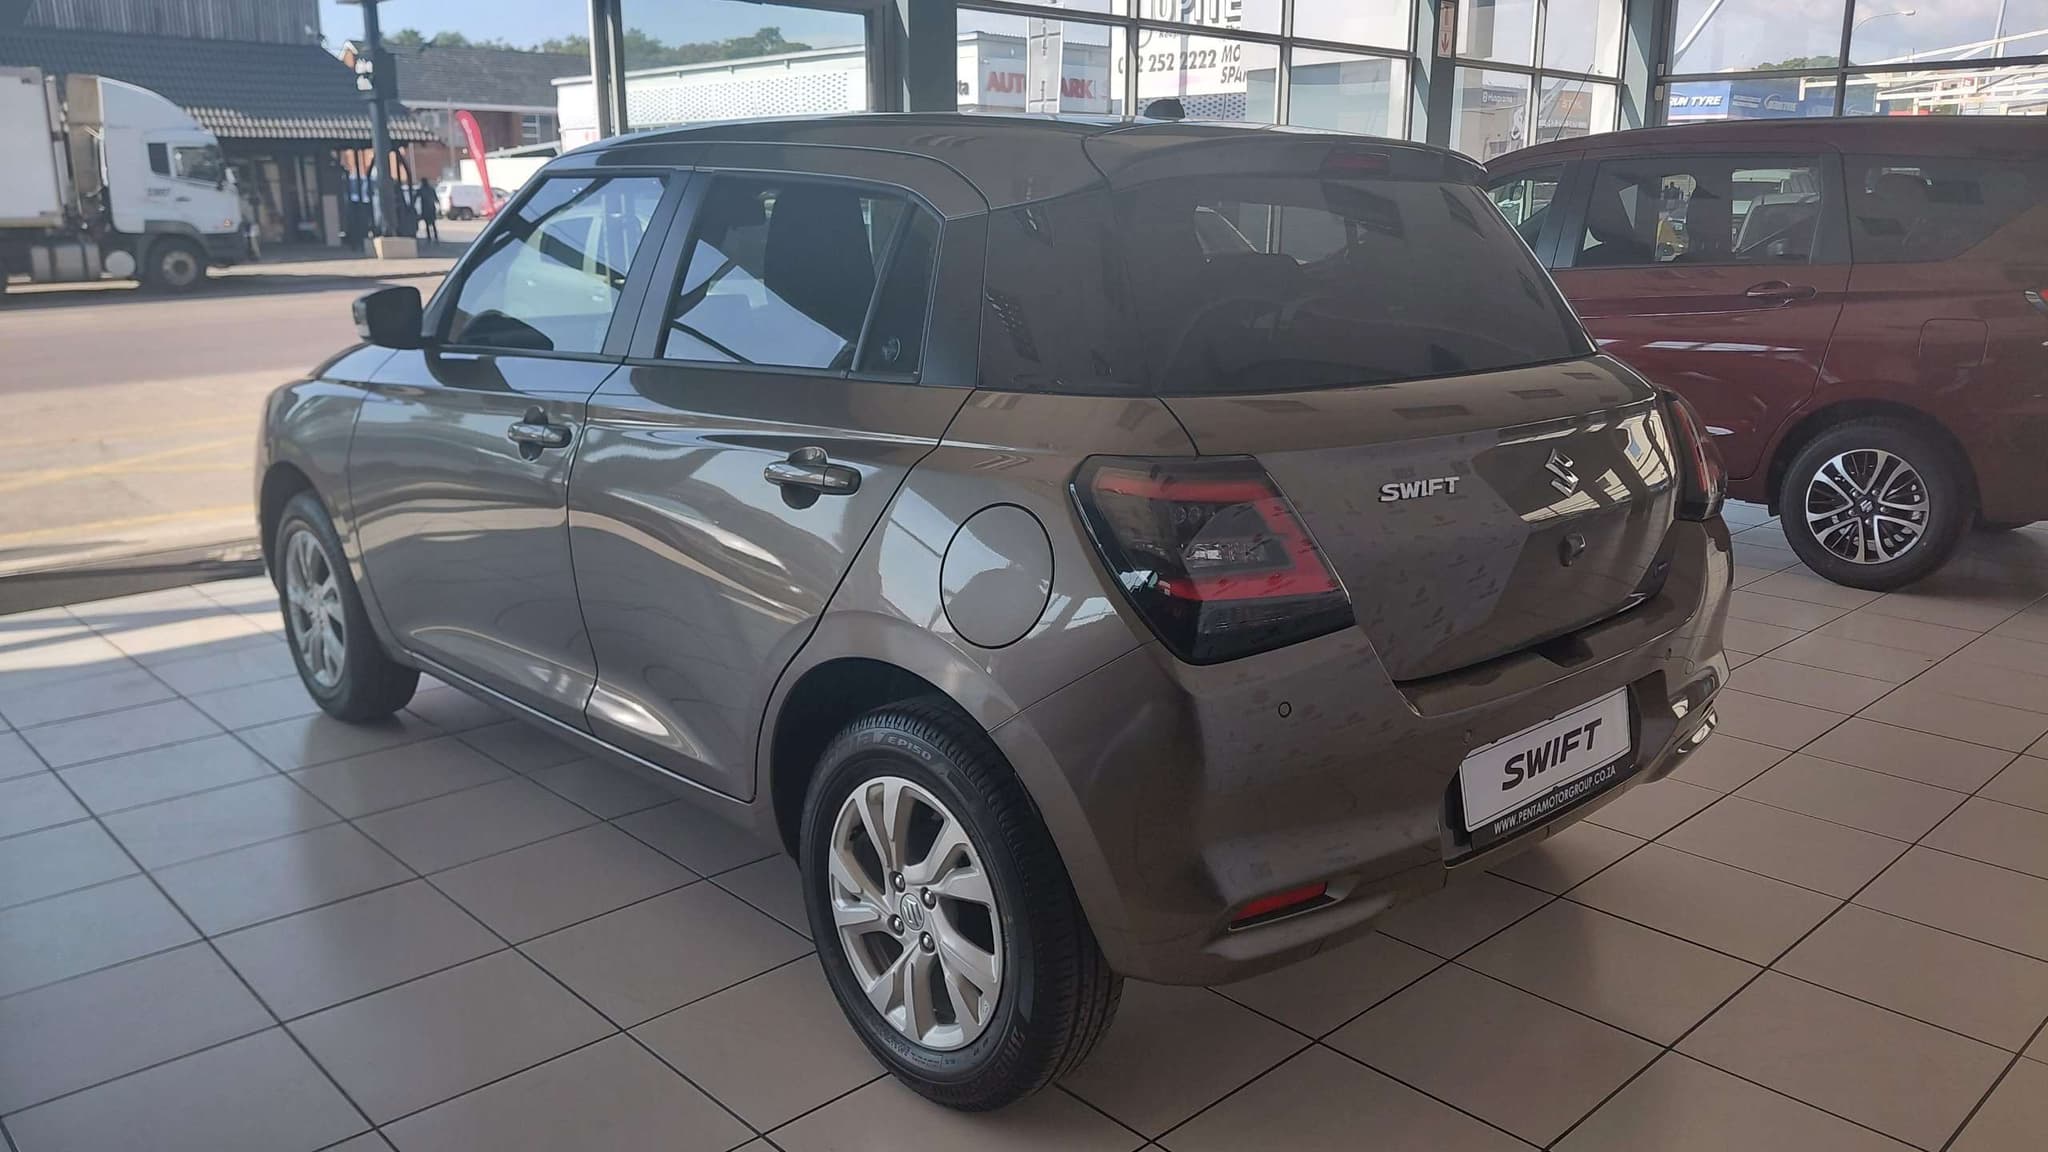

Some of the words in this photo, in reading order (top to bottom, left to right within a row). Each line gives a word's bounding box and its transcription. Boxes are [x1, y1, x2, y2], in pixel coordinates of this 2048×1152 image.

[1117, 55, 1144, 75] 02
[1148, 53, 1175, 73] 252
[1180, 49, 1217, 70] 2222
[986, 72, 1026, 94] AUT
[1690, 95, 1723, 106] TYRE
[1379, 476, 1460, 502] SWIFT
[1502, 718, 1602, 791] SWIFT
[1494, 765, 1616, 834] WWW.PENTAMOTORGROUP.CO.ZA
